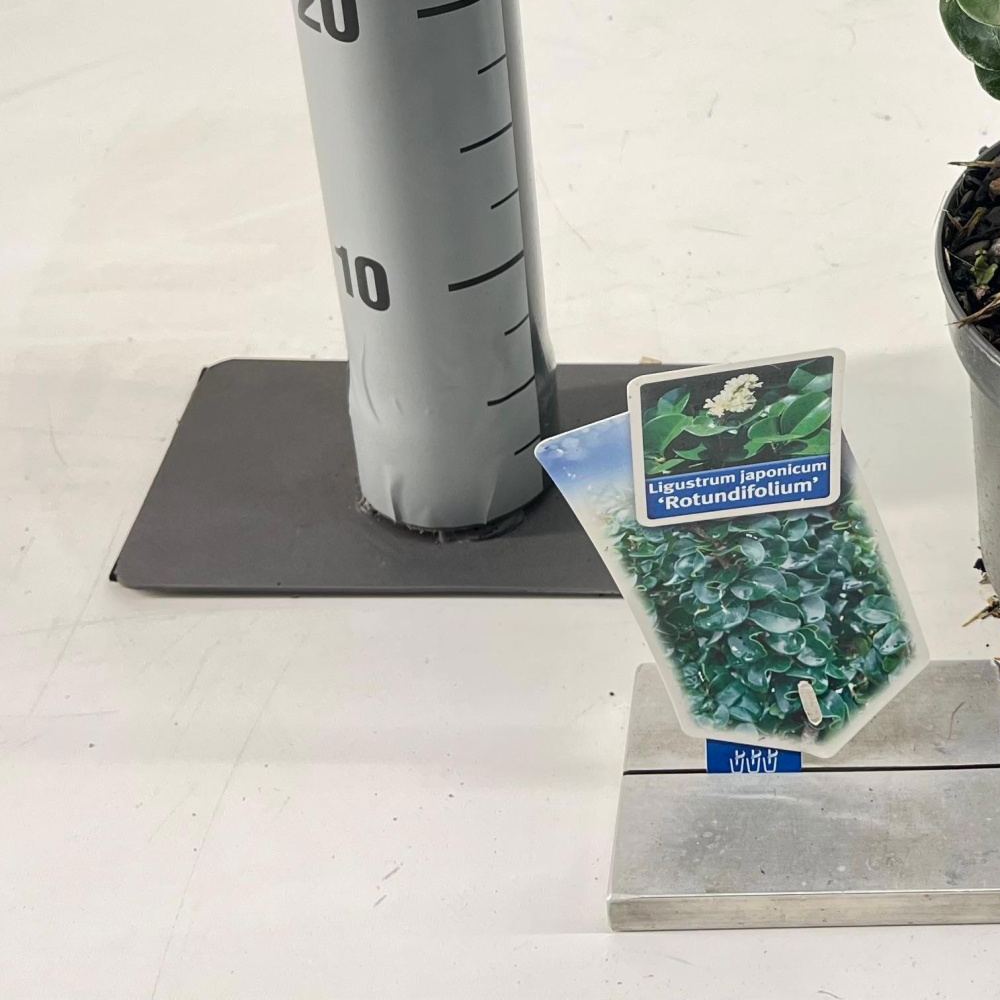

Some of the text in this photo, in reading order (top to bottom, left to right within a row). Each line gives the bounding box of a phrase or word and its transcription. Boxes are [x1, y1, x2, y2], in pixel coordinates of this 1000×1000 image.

[335, 245, 390, 311] 10
[648, 461, 827, 495] Ligustrum japonicum
